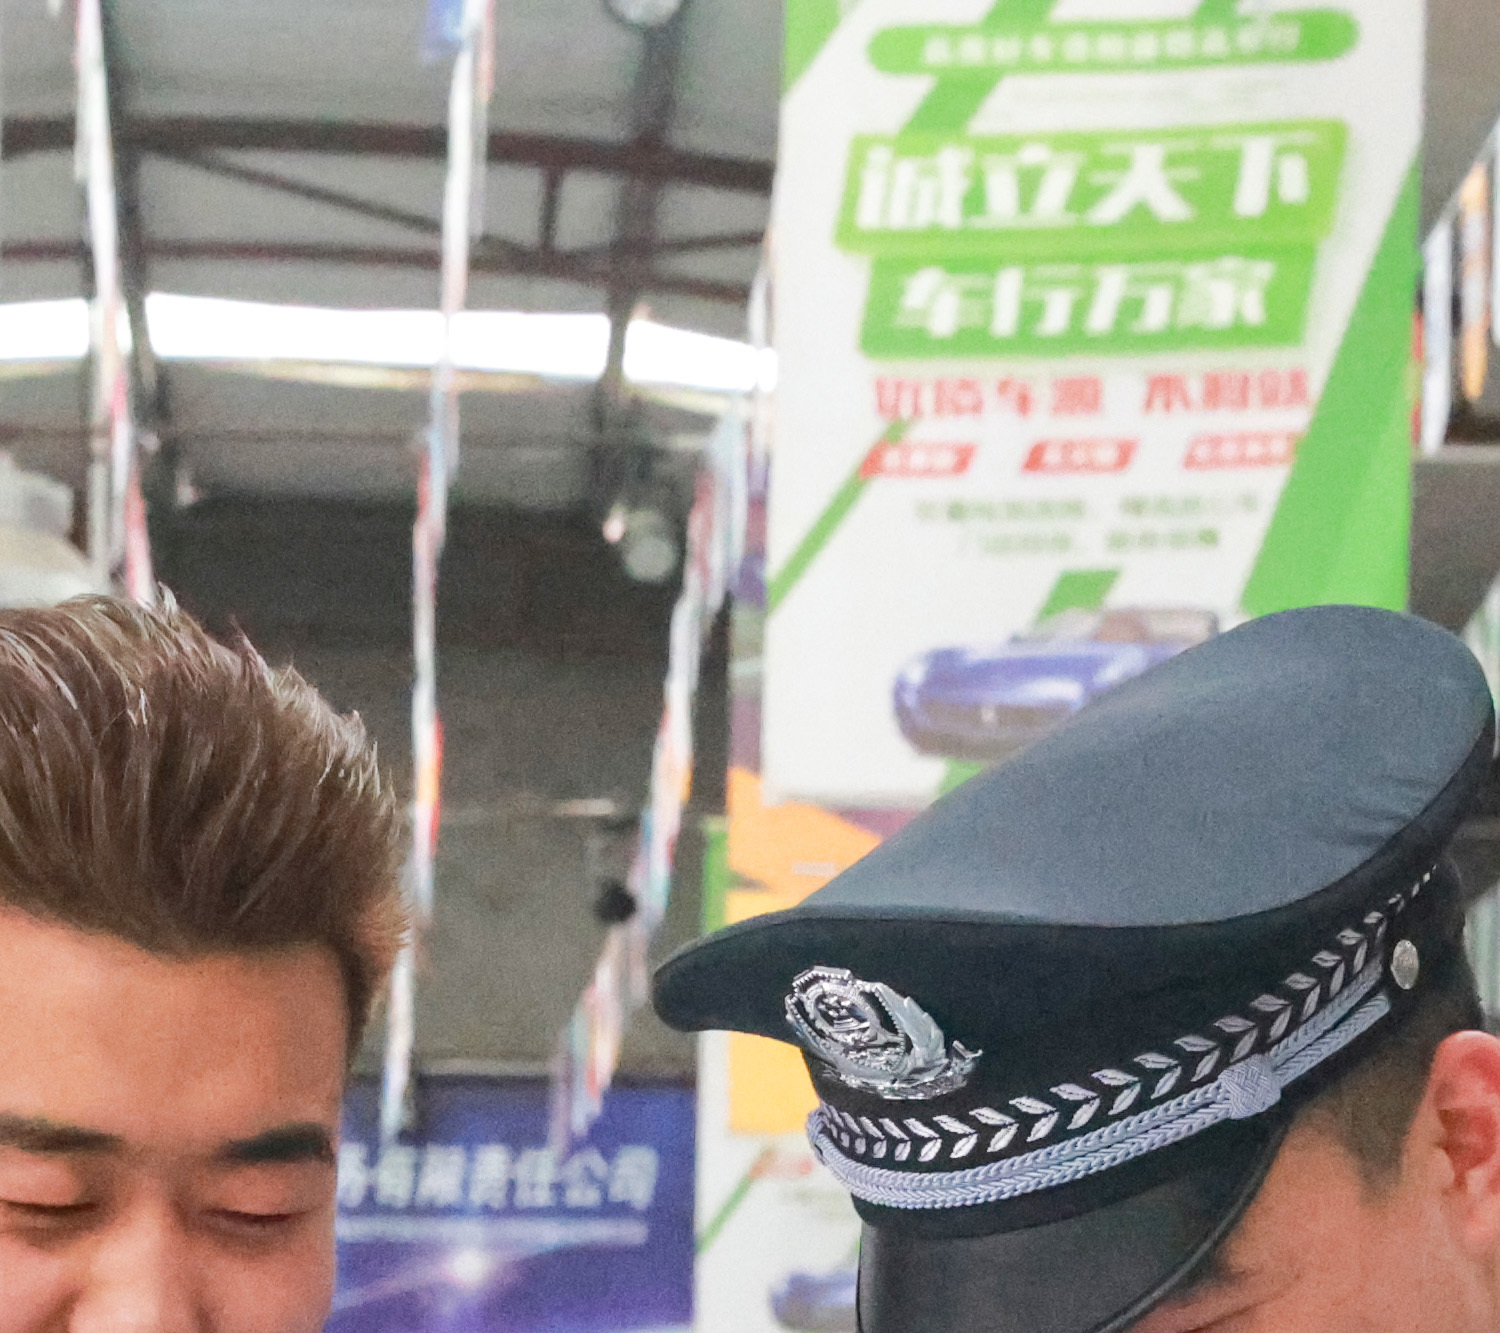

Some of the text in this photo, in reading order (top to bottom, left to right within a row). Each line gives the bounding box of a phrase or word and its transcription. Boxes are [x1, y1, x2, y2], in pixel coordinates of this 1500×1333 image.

[853, 132, 1316, 232] 诚立天下
[897, 254, 1277, 339] 车行万家
